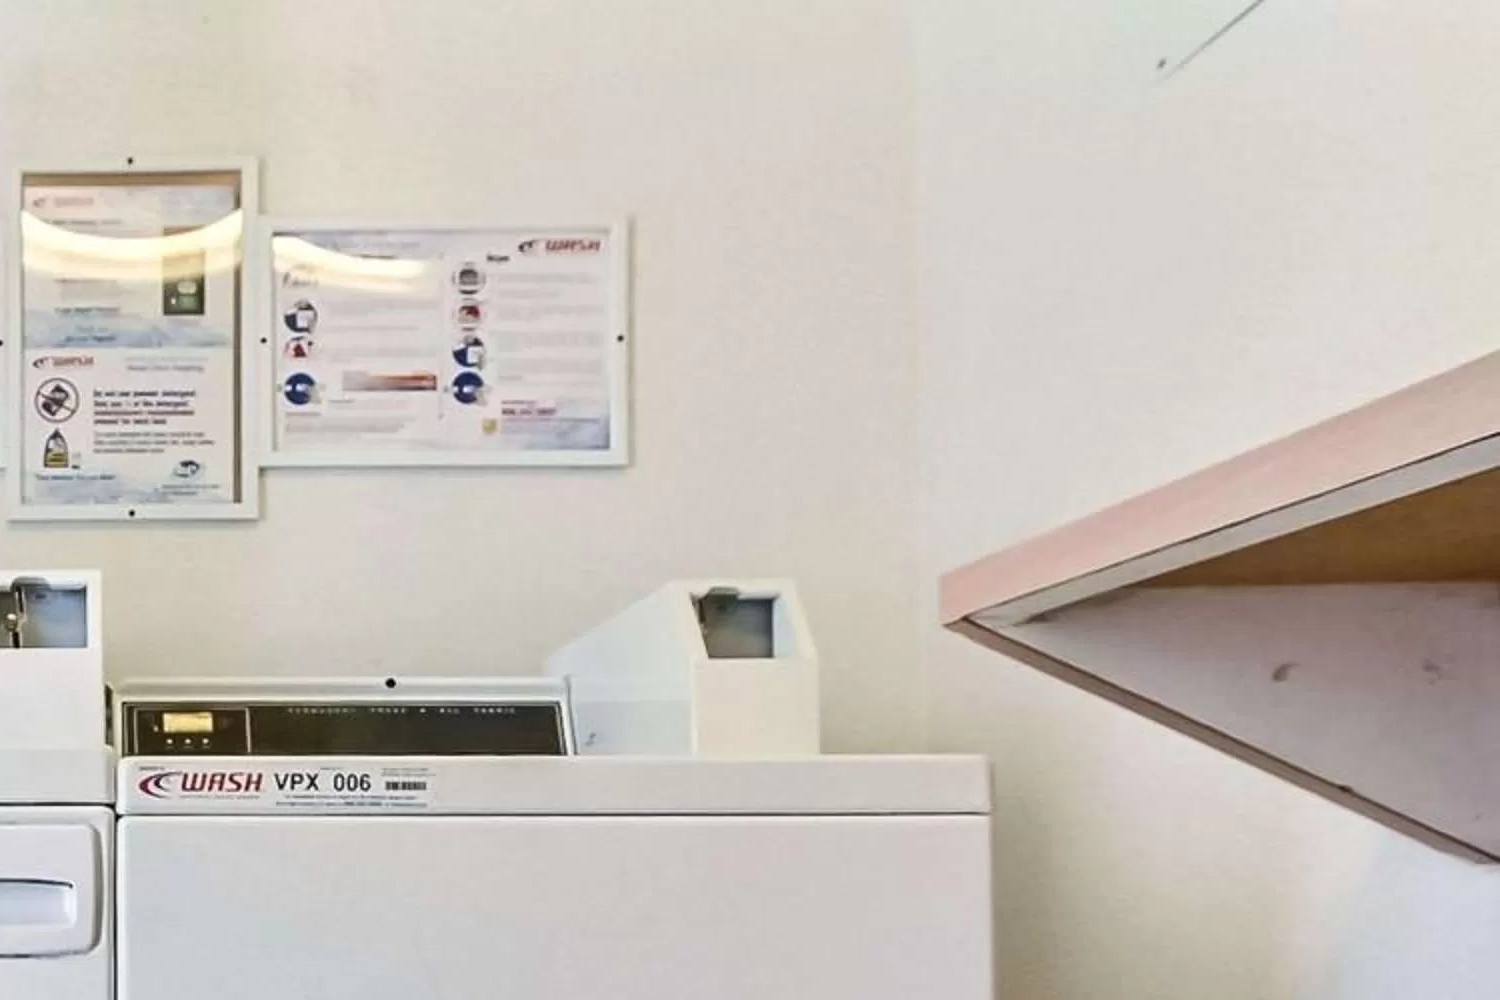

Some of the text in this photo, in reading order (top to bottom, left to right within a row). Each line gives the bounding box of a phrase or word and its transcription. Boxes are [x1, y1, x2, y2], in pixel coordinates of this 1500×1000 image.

[181, 772, 372, 793] WASH VPX 006
